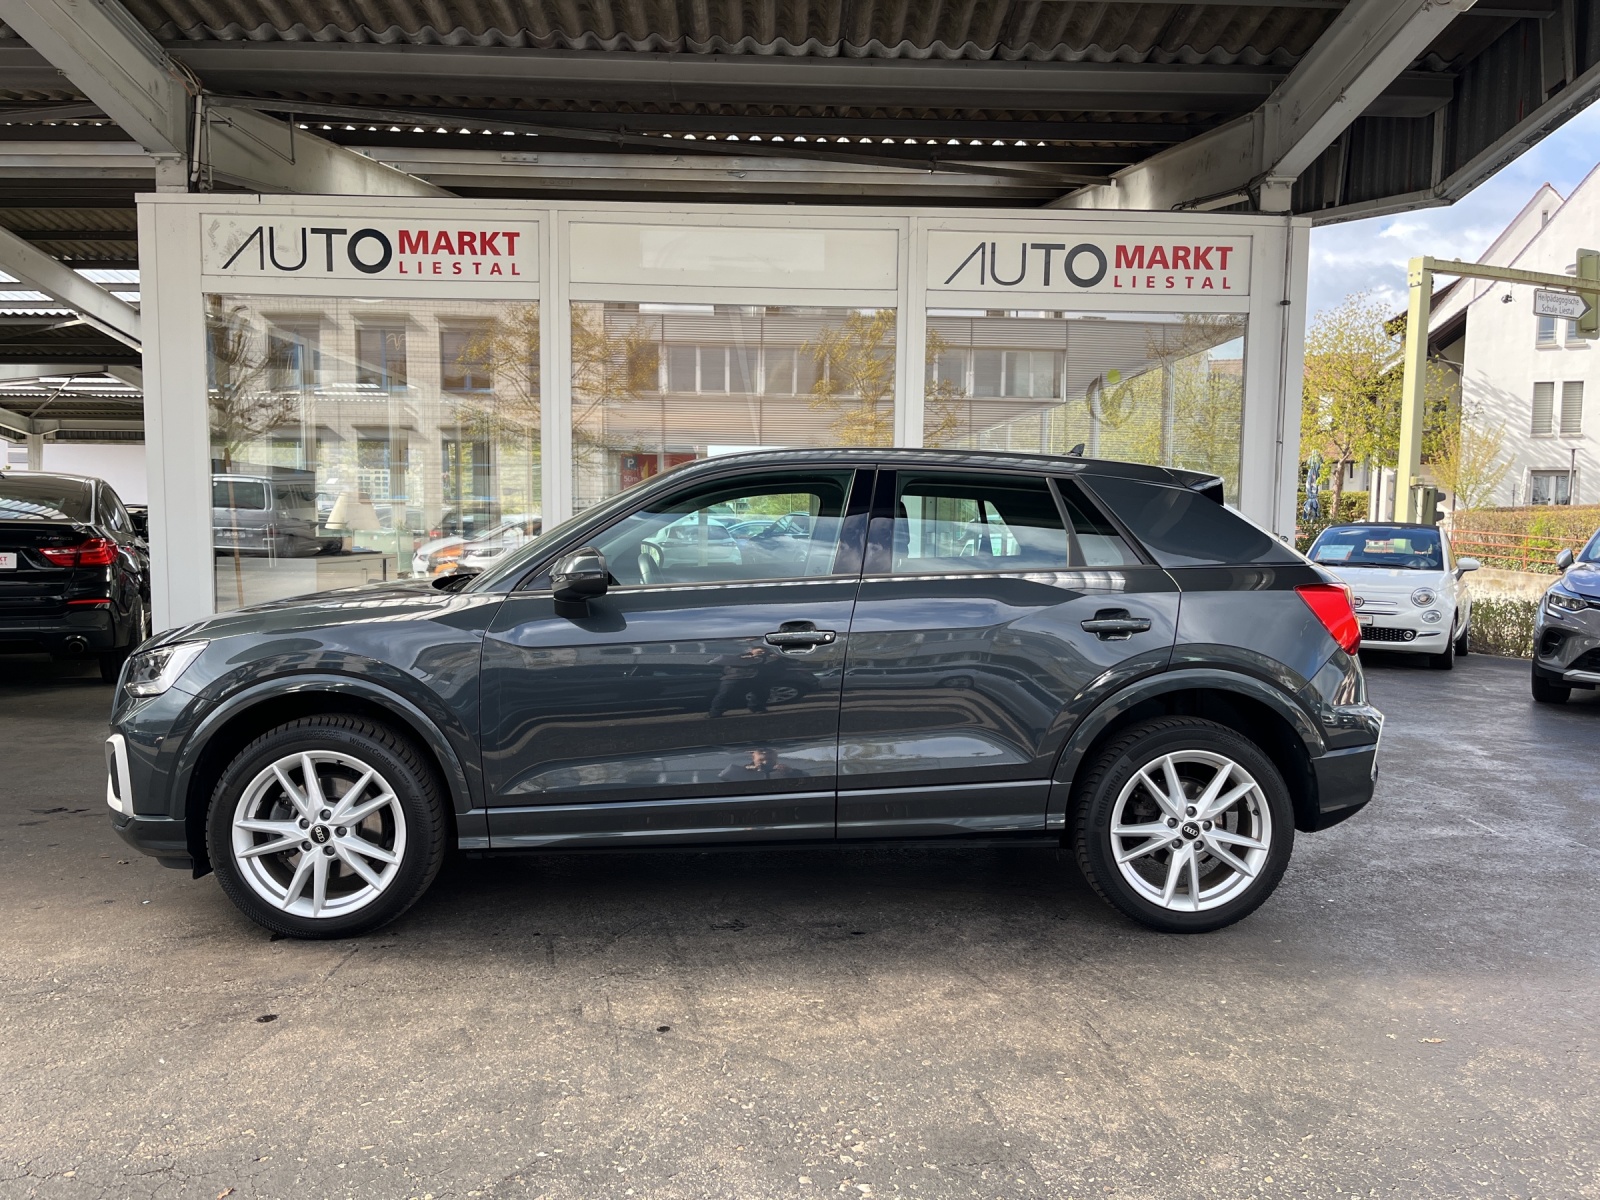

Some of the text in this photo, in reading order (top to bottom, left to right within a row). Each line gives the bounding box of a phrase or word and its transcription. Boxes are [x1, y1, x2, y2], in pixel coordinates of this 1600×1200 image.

[221, 226, 520, 274] AUTO MARKT
[398, 261, 520, 276] LIESTAL
[944, 242, 1233, 288] AUTO MARKT
[1114, 276, 1231, 290] LIESTAL
[1541, 304, 1575, 315] Schule Liestal
